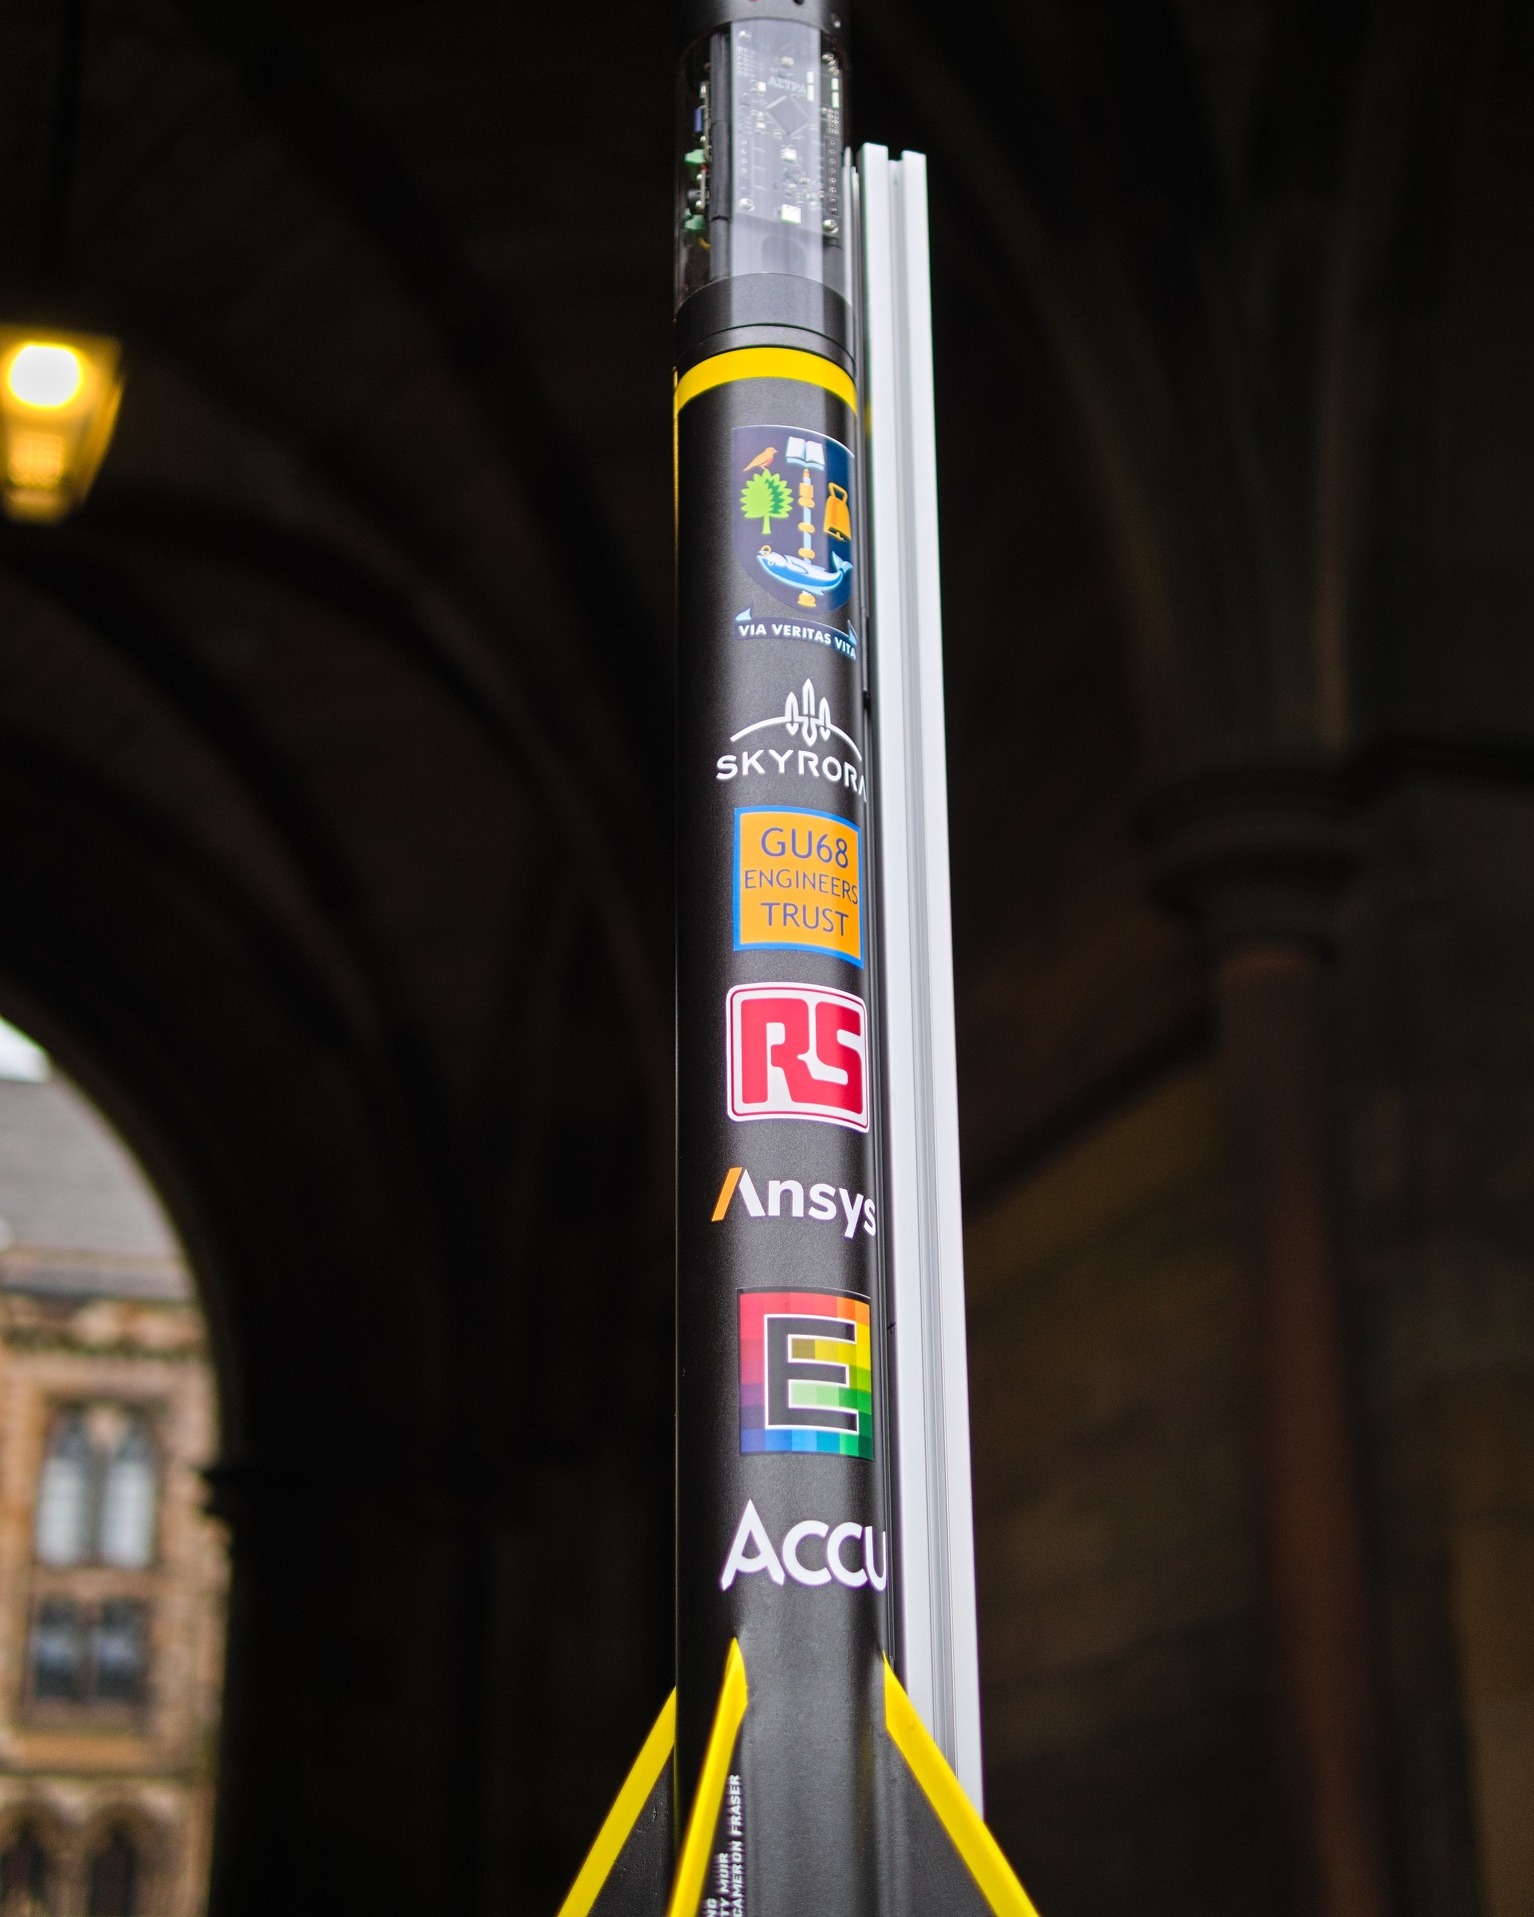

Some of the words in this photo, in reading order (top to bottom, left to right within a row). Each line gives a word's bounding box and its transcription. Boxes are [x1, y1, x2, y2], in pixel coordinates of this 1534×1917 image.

[738, 624, 766, 637] VIA
[771, 623, 832, 645] VERITAS
[834, 636, 857, 660] VITA
[716, 750, 867, 802] SKYRORA
[760, 827, 849, 868] GU68
[744, 868, 858, 905] ENGINEERS
[760, 902, 849, 936] TRUST
[740, 997, 863, 1115] RS
[711, 1166, 876, 1239] Ansys
[729, 1774, 743, 1836] FRASER
[718, 1852, 729, 1894] MUIR
[731, 1840, 743, 1917] CAMERON
